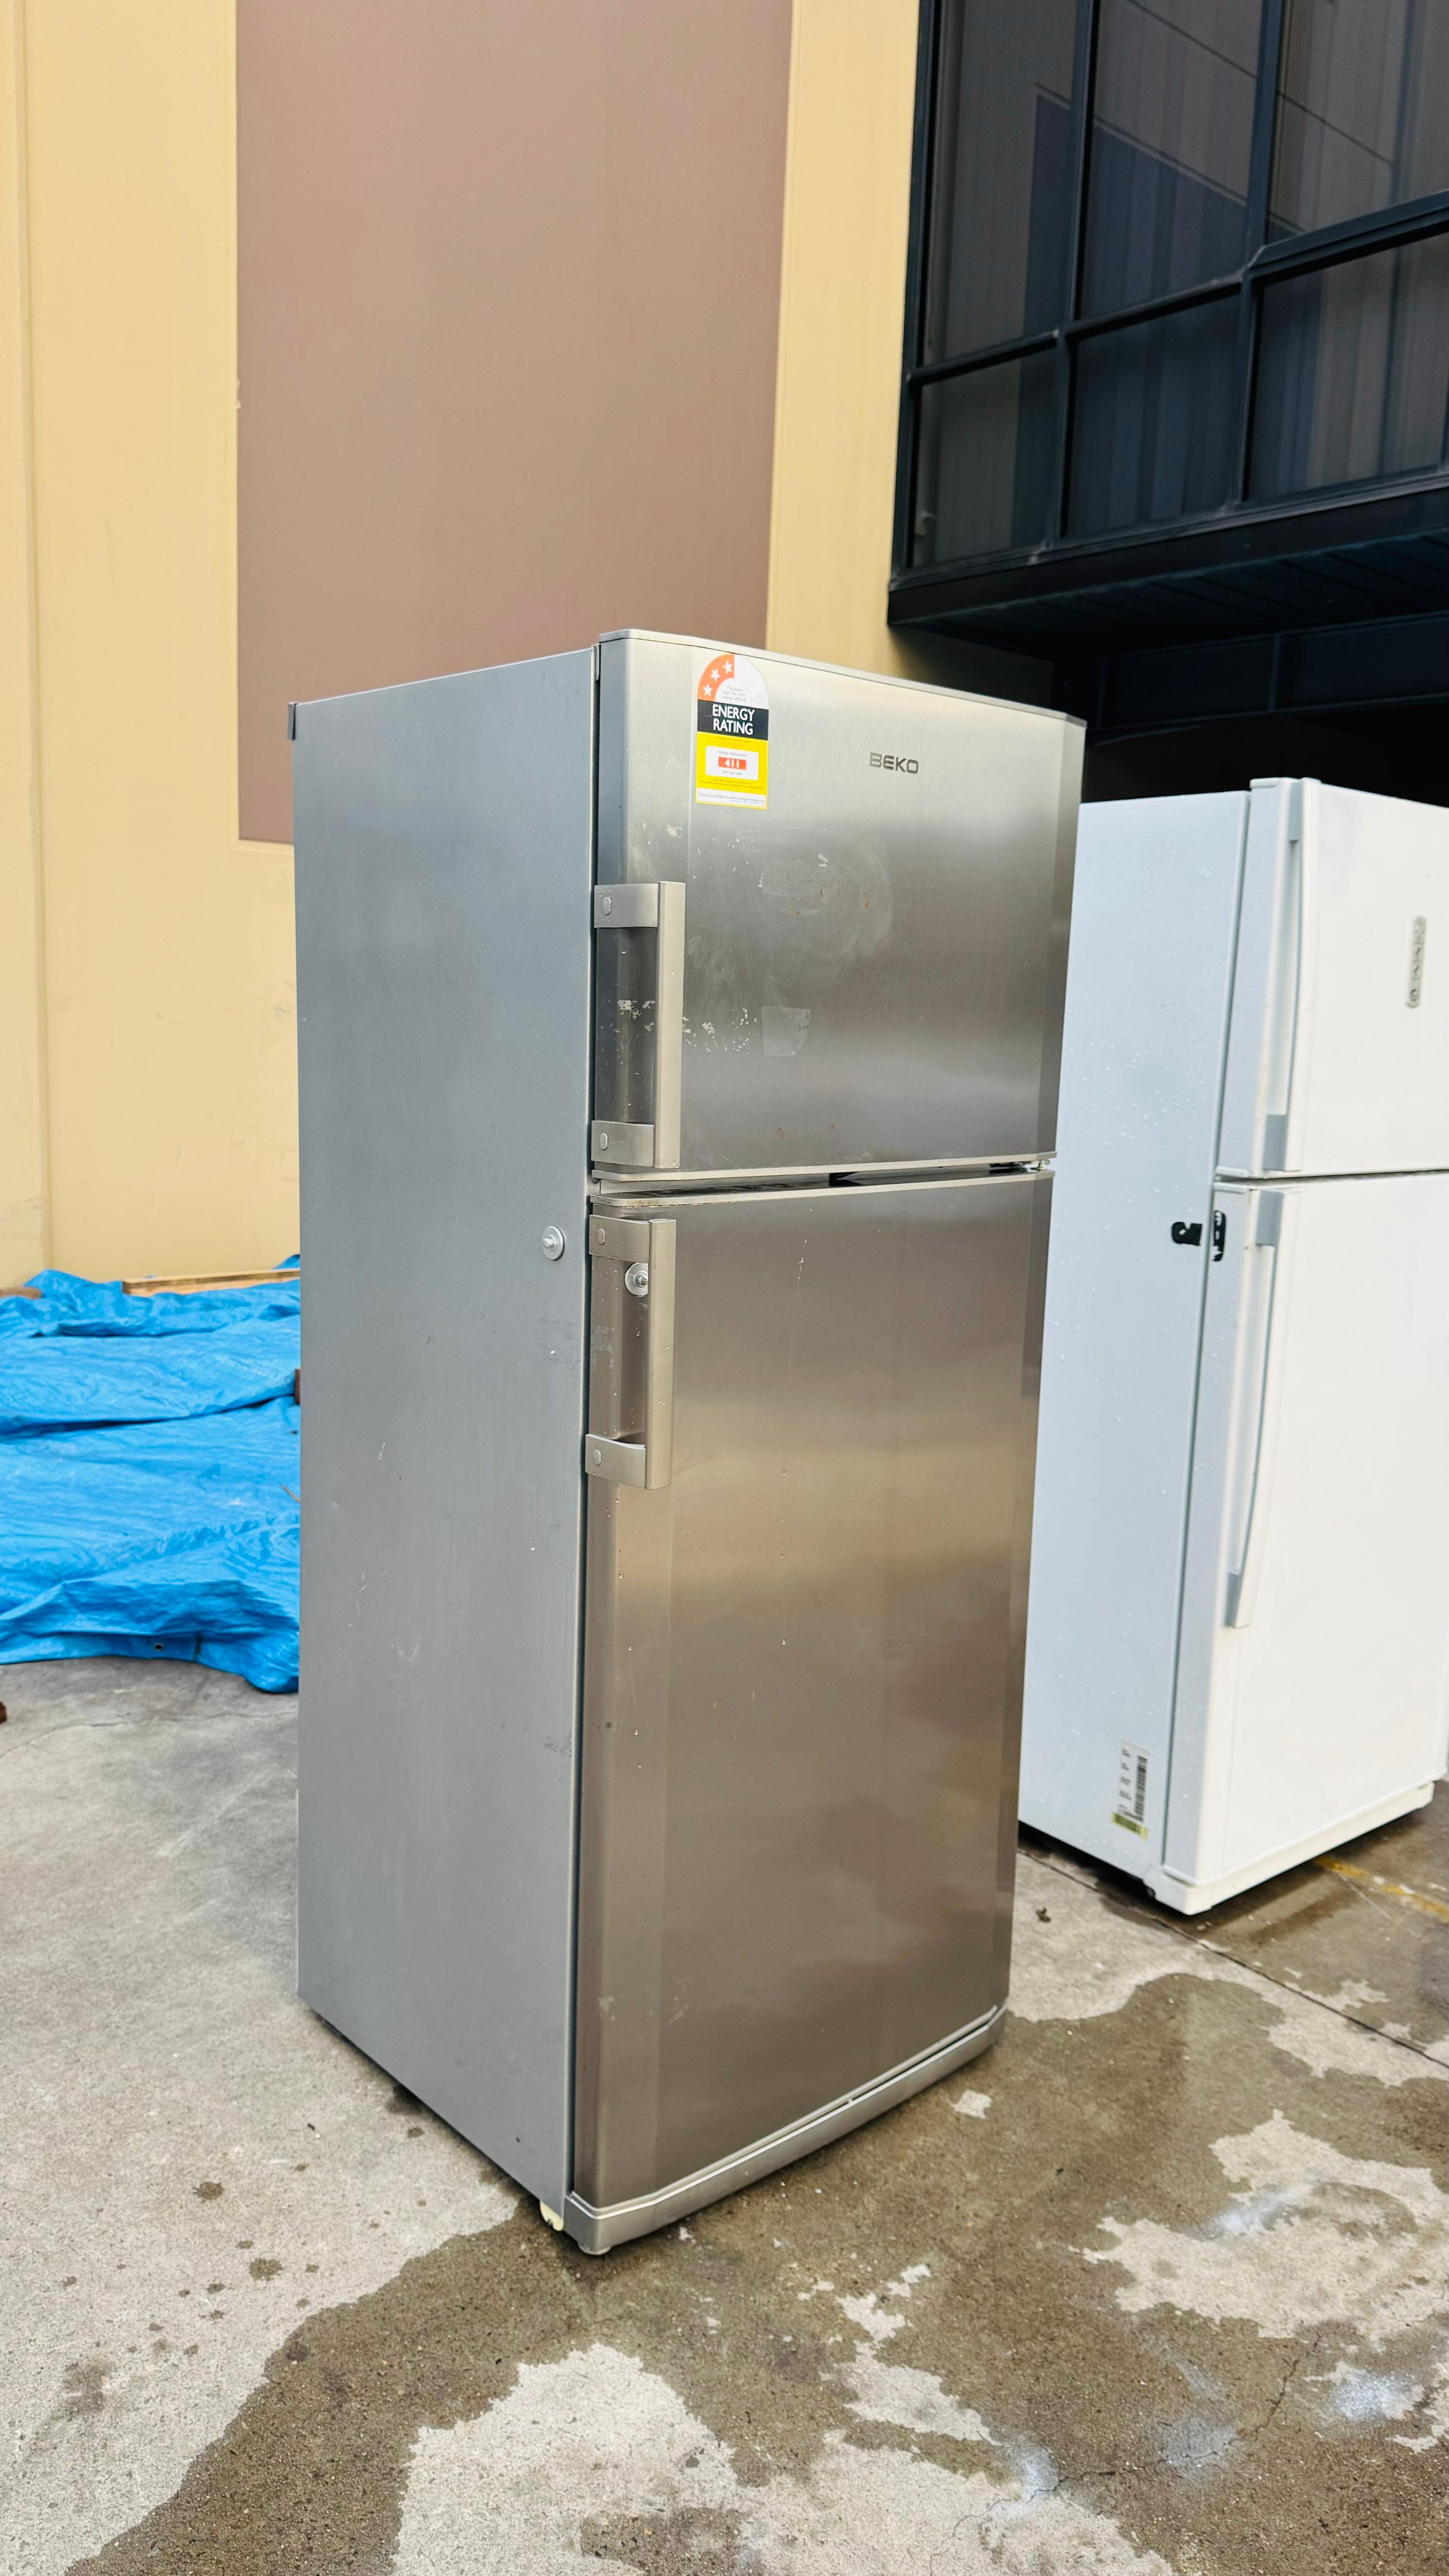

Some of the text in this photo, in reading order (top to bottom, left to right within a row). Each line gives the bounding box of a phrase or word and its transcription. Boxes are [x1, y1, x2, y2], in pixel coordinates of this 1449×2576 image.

[712, 703, 755, 721] ENERGY
[713, 718, 754, 736] RATING
[725, 758, 740, 769] 411
[869, 752, 919, 774] BEKO
